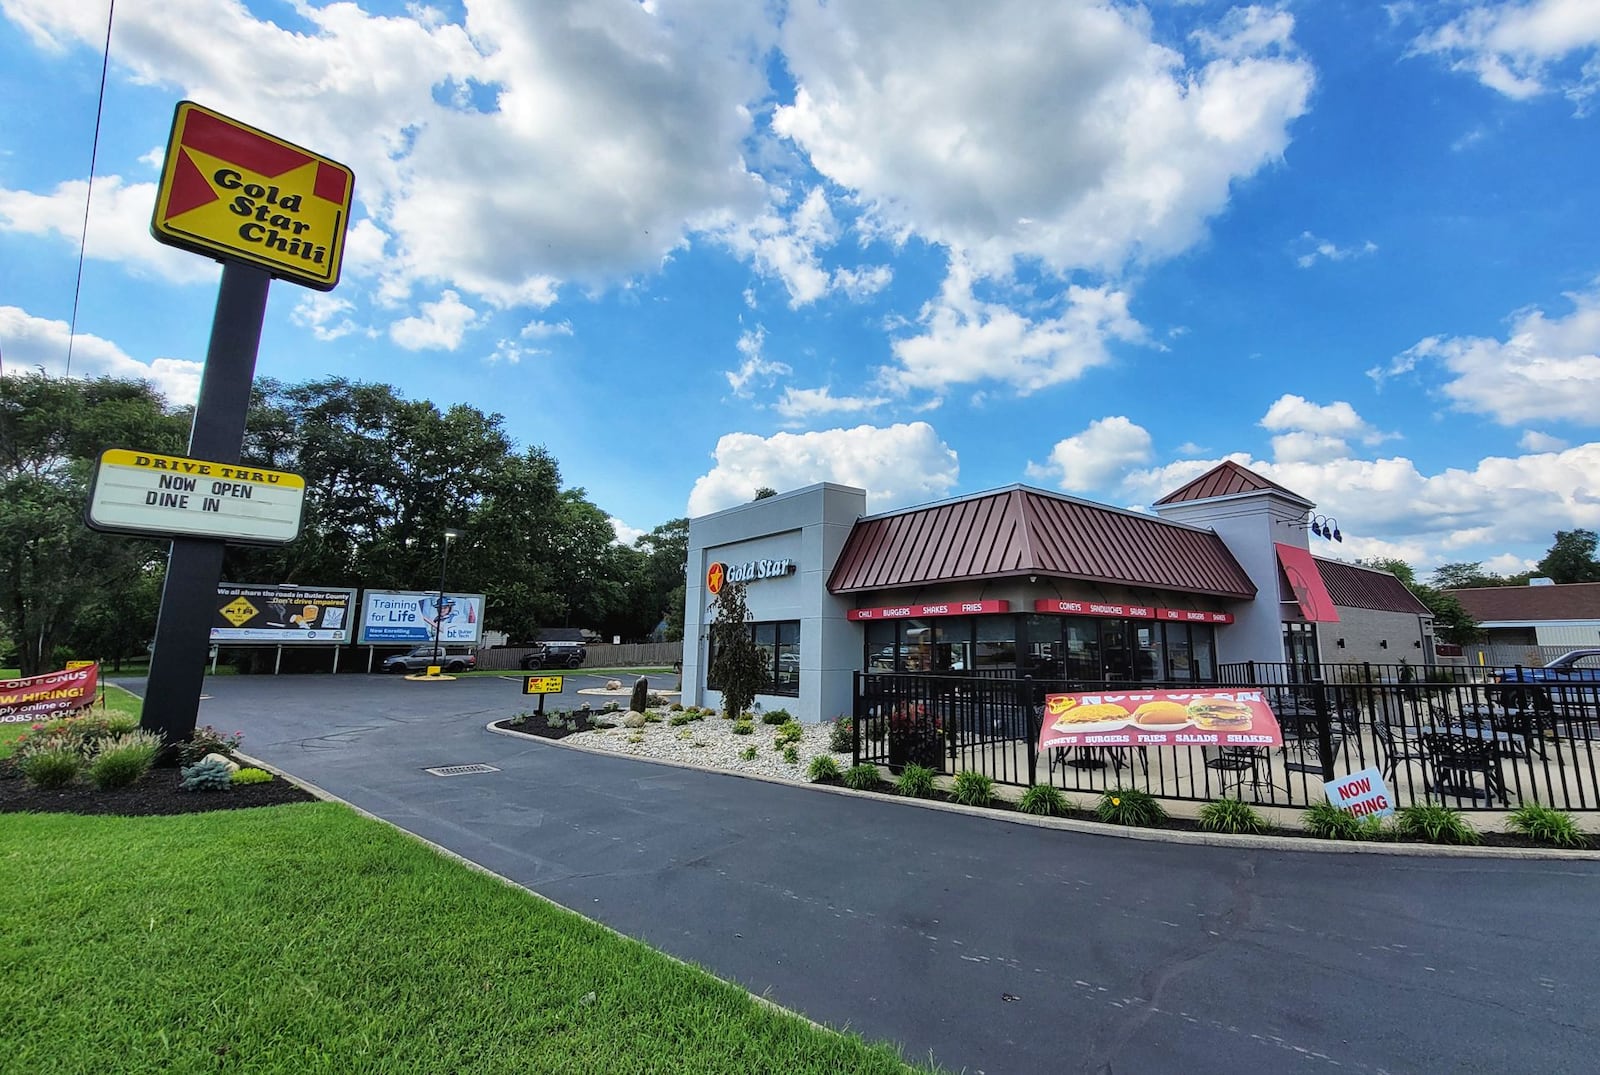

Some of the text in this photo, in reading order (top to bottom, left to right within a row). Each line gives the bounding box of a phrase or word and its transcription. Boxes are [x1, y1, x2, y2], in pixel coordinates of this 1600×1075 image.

[214, 168, 303, 213] Gold
[229, 195, 310, 235] Star
[238, 222, 327, 264] Chili
[135, 456, 280, 484] DRIVE THRU
[158, 474, 253, 499] NOW OPEN
[145, 491, 221, 513] DINE IN
[726, 558, 790, 583] Gold Star
[373, 598, 417, 611] Training
[858, 603, 982, 618] CHILI BURGERS SHAKES FRIES
[1058, 601, 1082, 611] CONEYS
[1090, 604, 1123, 615] SANDWICHES
[1129, 607, 1147, 616] SALADS
[1187, 611, 1205, 620] BURGERS
[371, 610, 416, 622] for Life
[35, 671, 88, 685] BONUS
[22, 687, 84, 702] HIRING!
[20, 702, 57, 712] online
[1043, 734, 1273, 747] CONEYS BURGERS FRIES SALADS SHAKES
[1337, 777, 1371, 801] NOW
